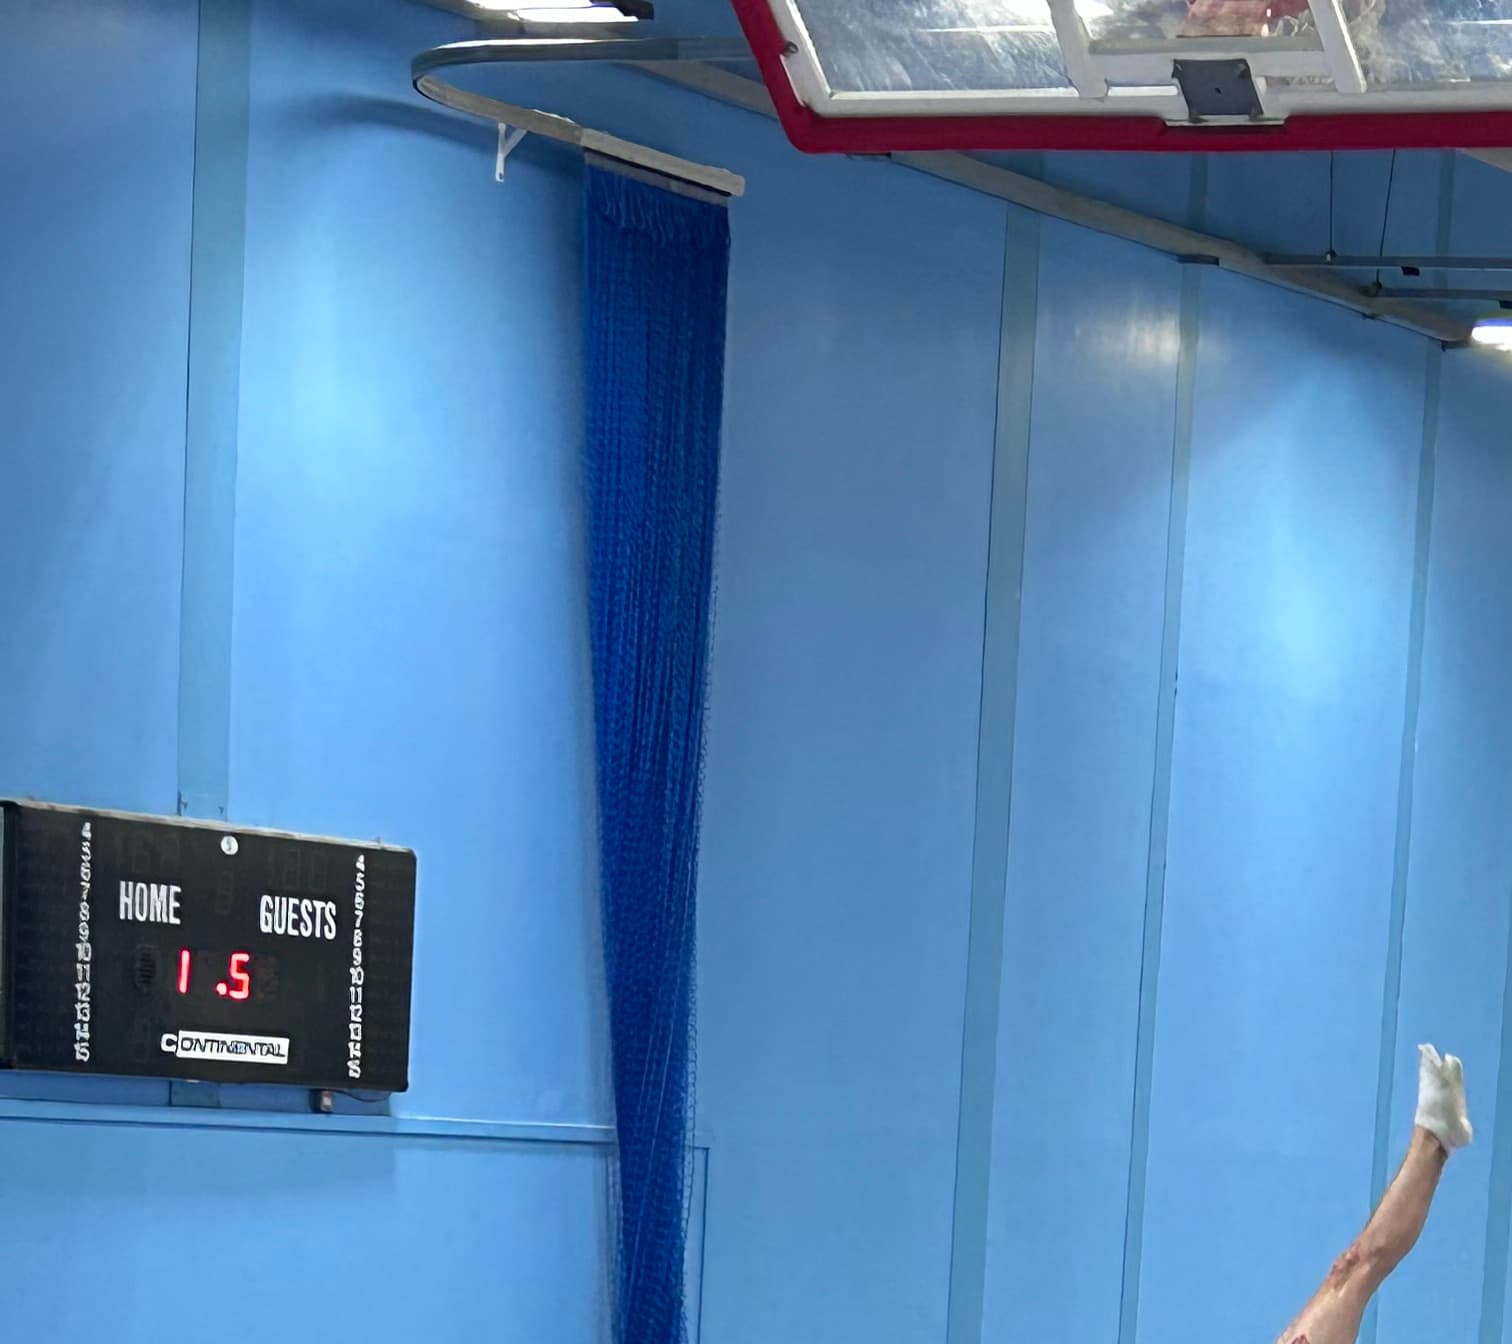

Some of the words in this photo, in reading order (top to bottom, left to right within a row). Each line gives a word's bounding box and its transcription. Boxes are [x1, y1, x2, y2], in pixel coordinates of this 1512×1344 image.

[119, 880, 182, 925] HOME
[259, 895, 337, 940] GUESTS
[178, 950, 191, 994] 1
[161, 1032, 287, 1058] CONTINENTAL
